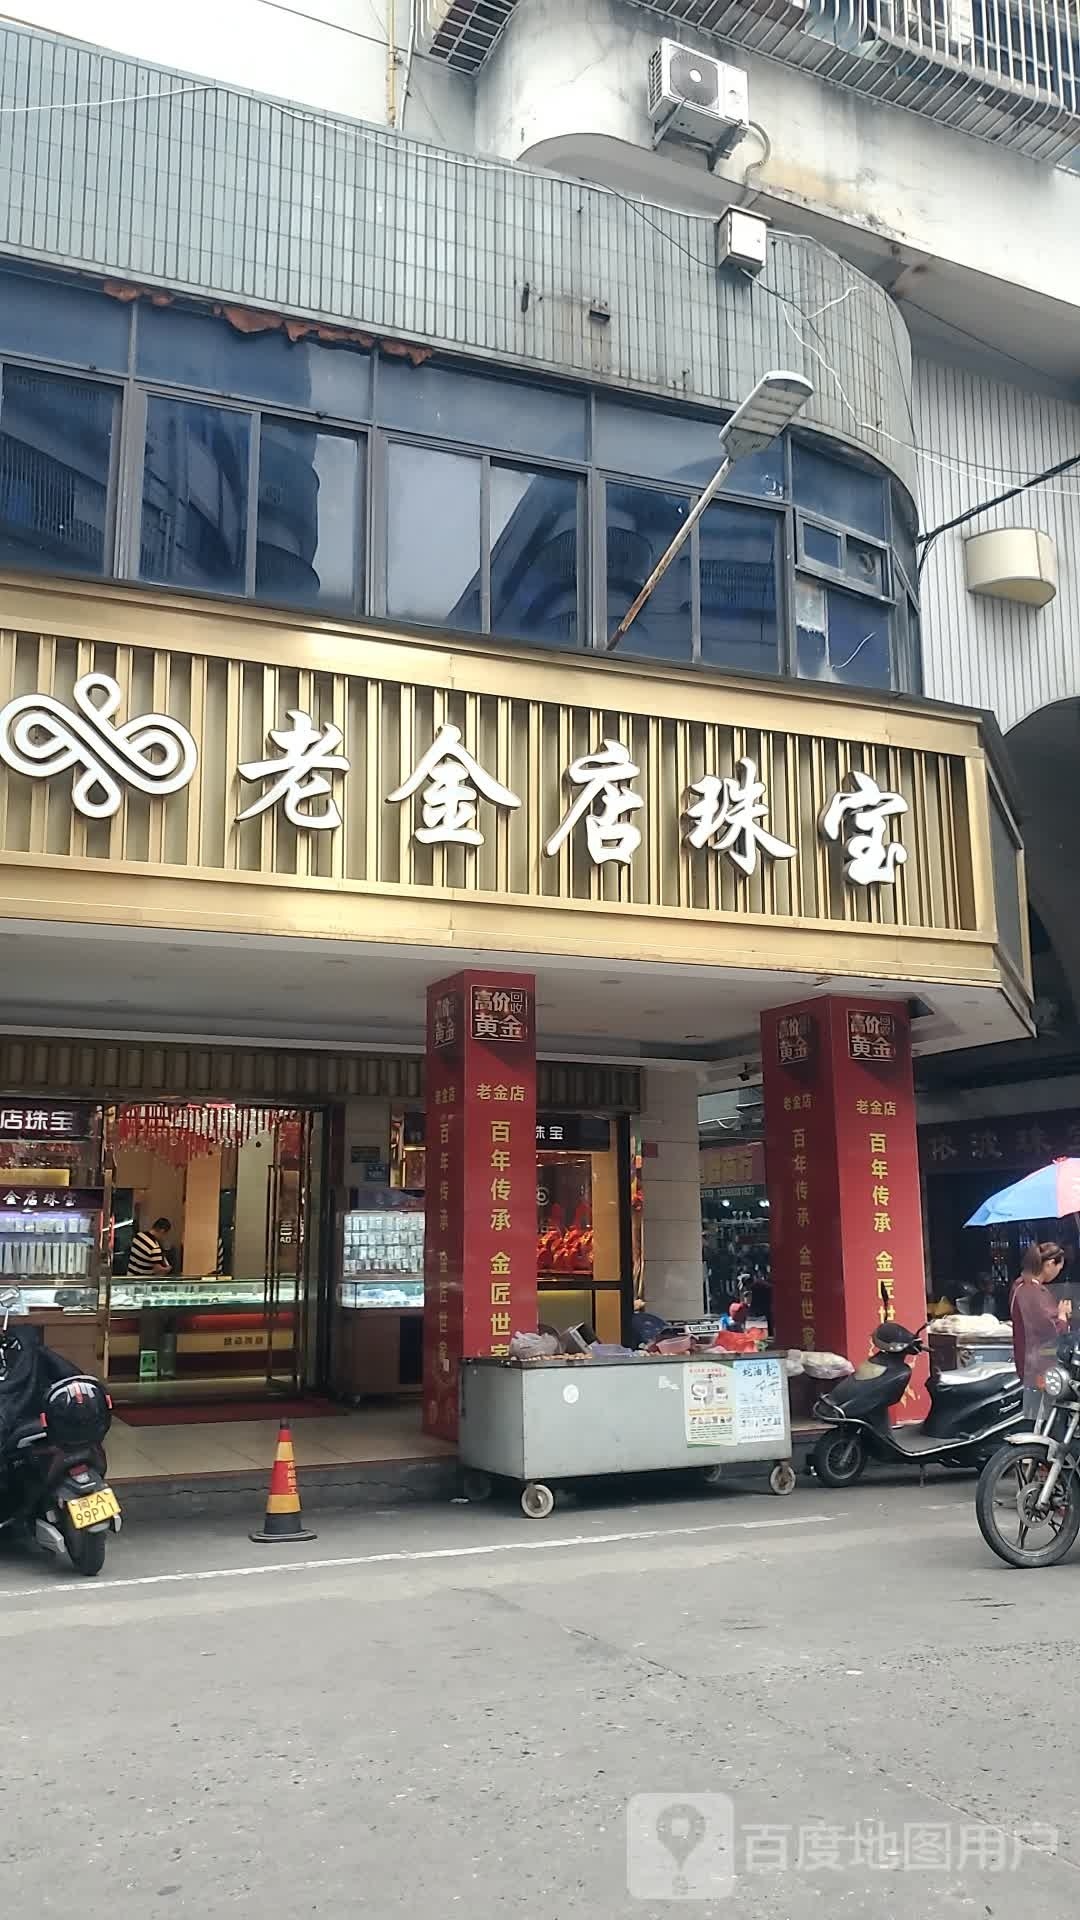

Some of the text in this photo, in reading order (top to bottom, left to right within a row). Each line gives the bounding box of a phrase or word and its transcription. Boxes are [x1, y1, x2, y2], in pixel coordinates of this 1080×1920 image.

[234, 710, 909, 886] 老金店珠宝
[475, 990, 511, 1012] 高价
[511, 991, 523, 1014] 回收
[474, 1013, 524, 1038] 黄金
[850, 1014, 880, 1034] 高价
[851, 1035, 892, 1058] 黄金
[477, 1084, 525, 1101] 老金店
[856, 1099, 896, 1116] 老金店
[490, 1120, 511, 1232] 百年传承
[869, 1133, 892, 1233] 百年传承
